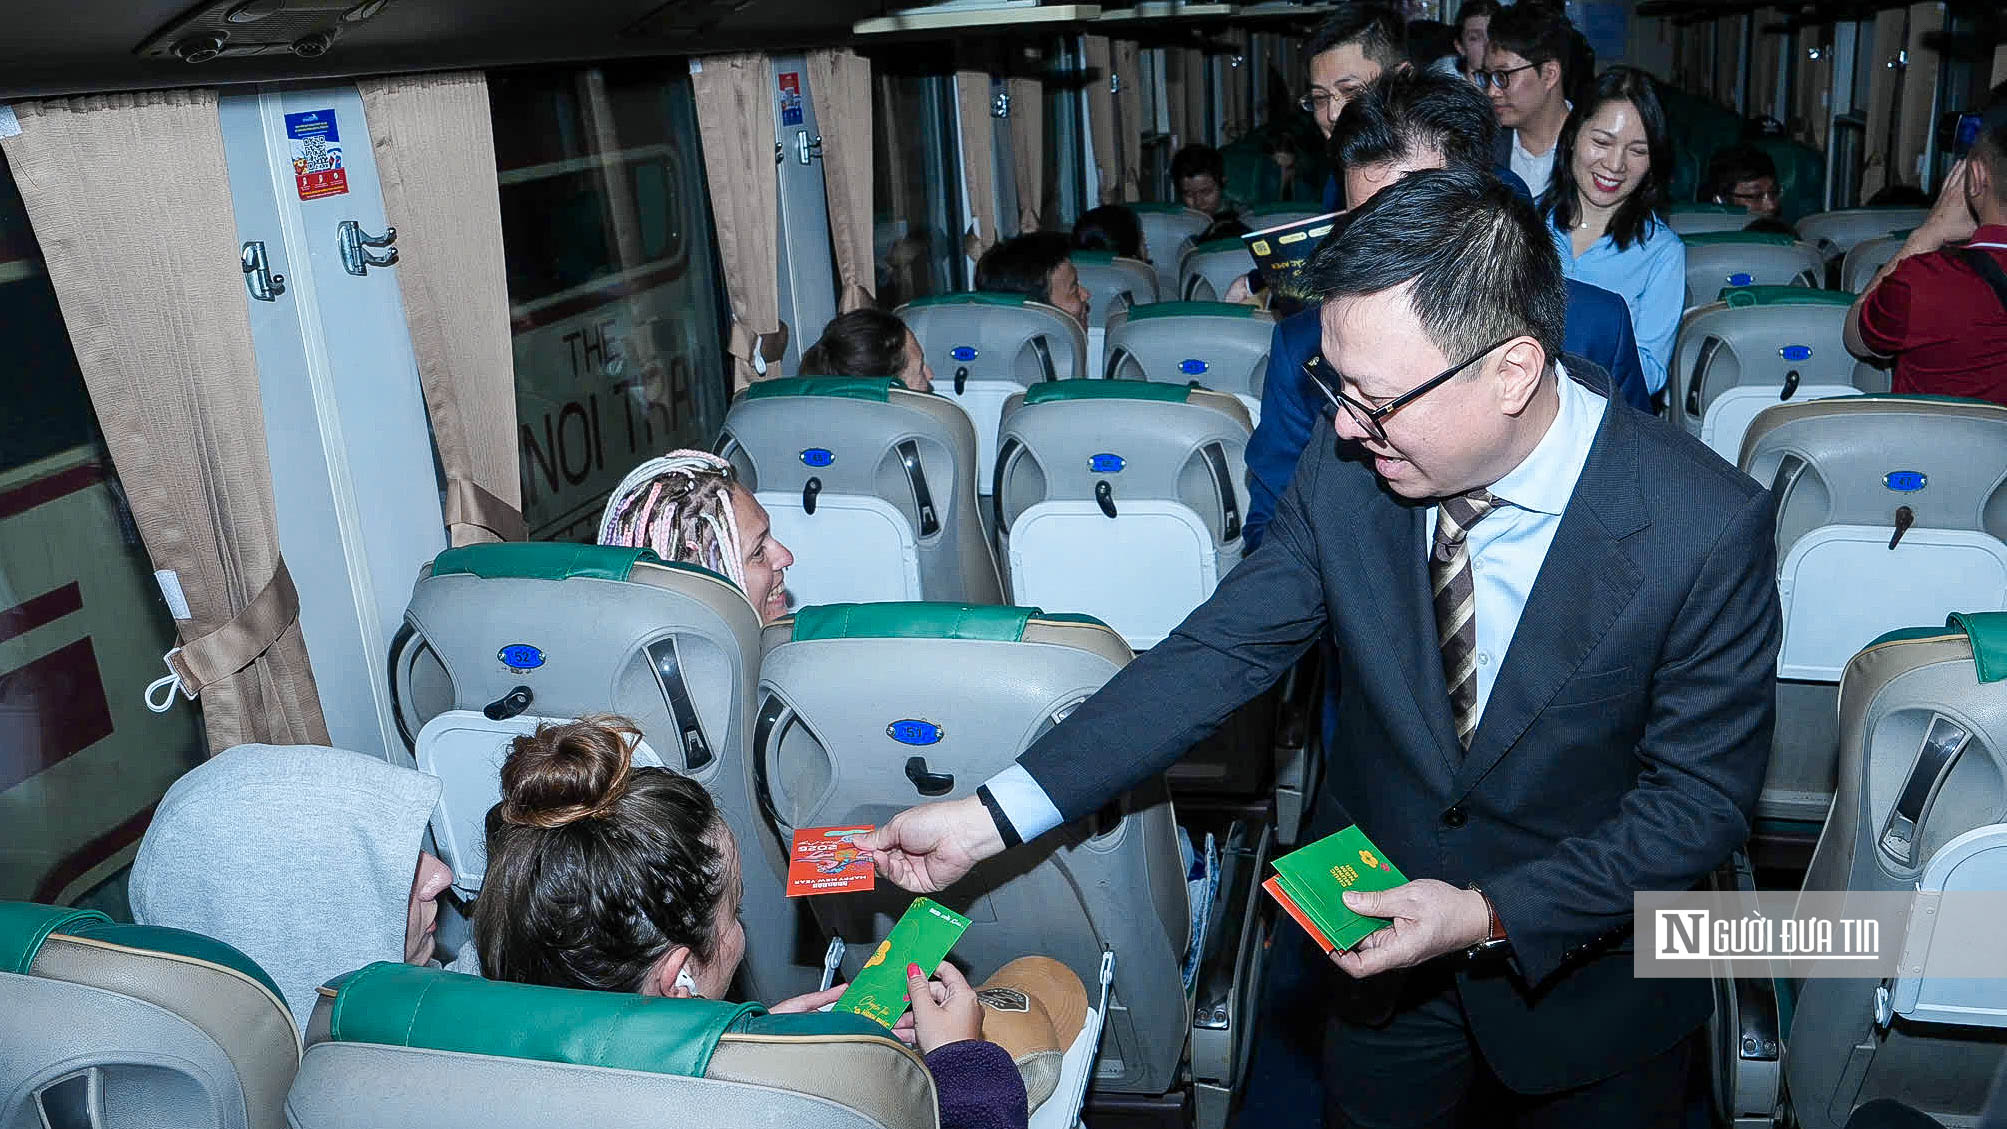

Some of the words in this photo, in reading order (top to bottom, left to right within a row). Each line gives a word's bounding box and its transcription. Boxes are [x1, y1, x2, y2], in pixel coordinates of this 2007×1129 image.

[562, 319, 620, 377] THE
[513, 650, 529, 663] 52
[905, 725, 922, 738] 51
[798, 844, 838, 852] 2026
